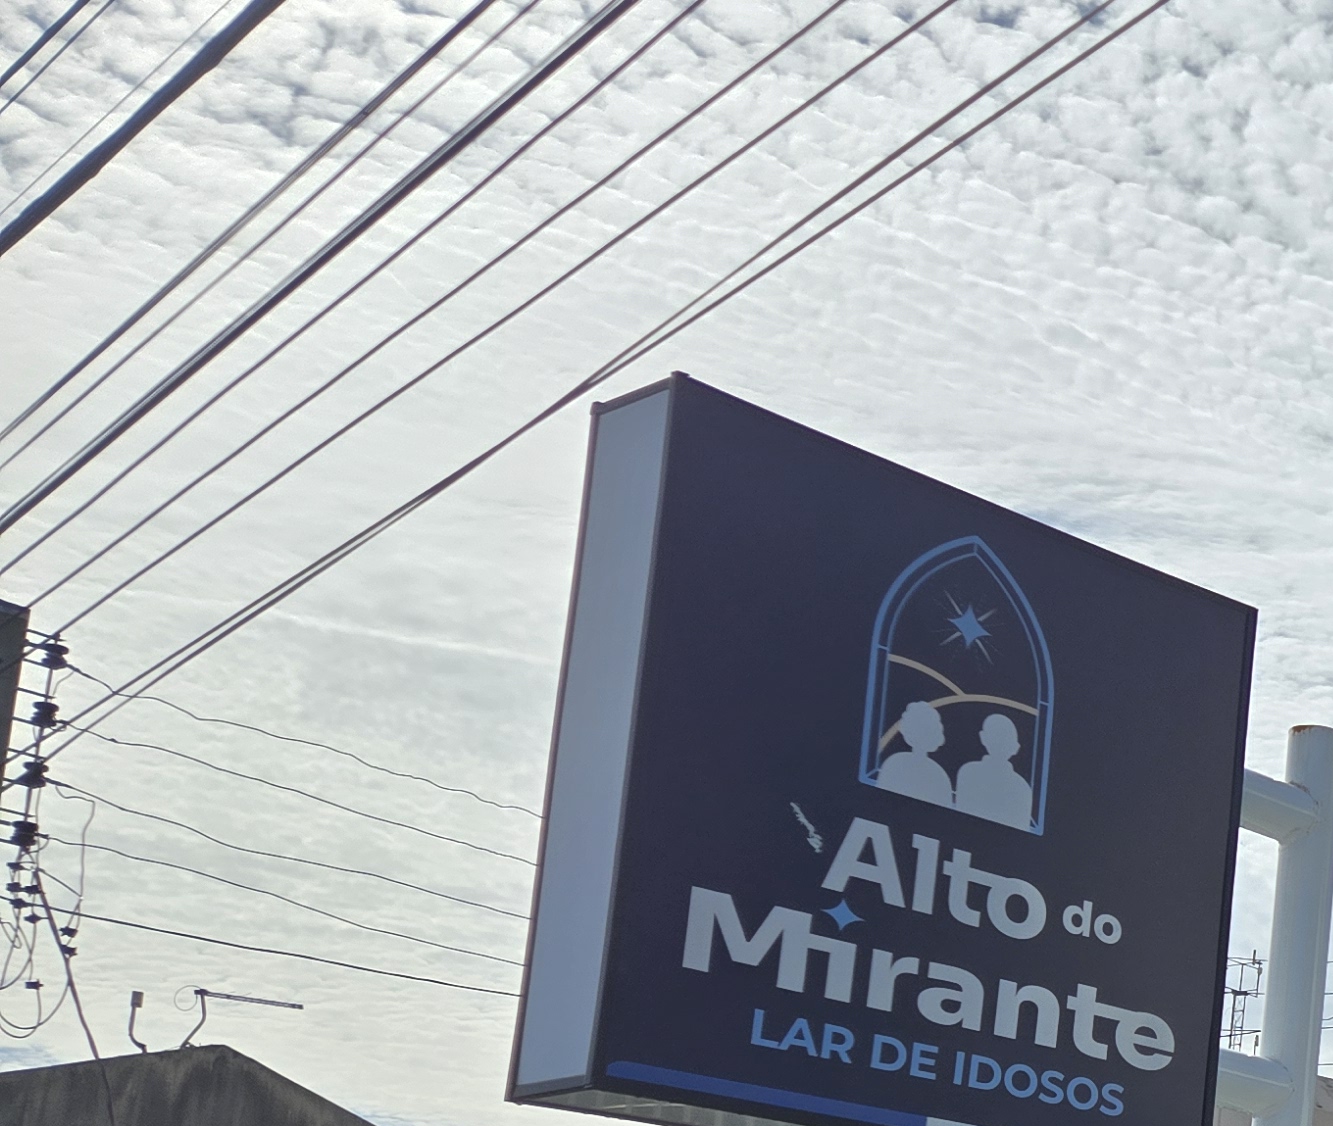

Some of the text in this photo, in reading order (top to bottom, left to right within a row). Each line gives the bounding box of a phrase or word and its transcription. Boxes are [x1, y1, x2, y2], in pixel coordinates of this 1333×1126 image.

[820, 815, 1123, 945] Alto do
[682, 885, 1175, 1071] Mirante
[750, 1008, 1125, 1117] LAR DE IDOSOS
